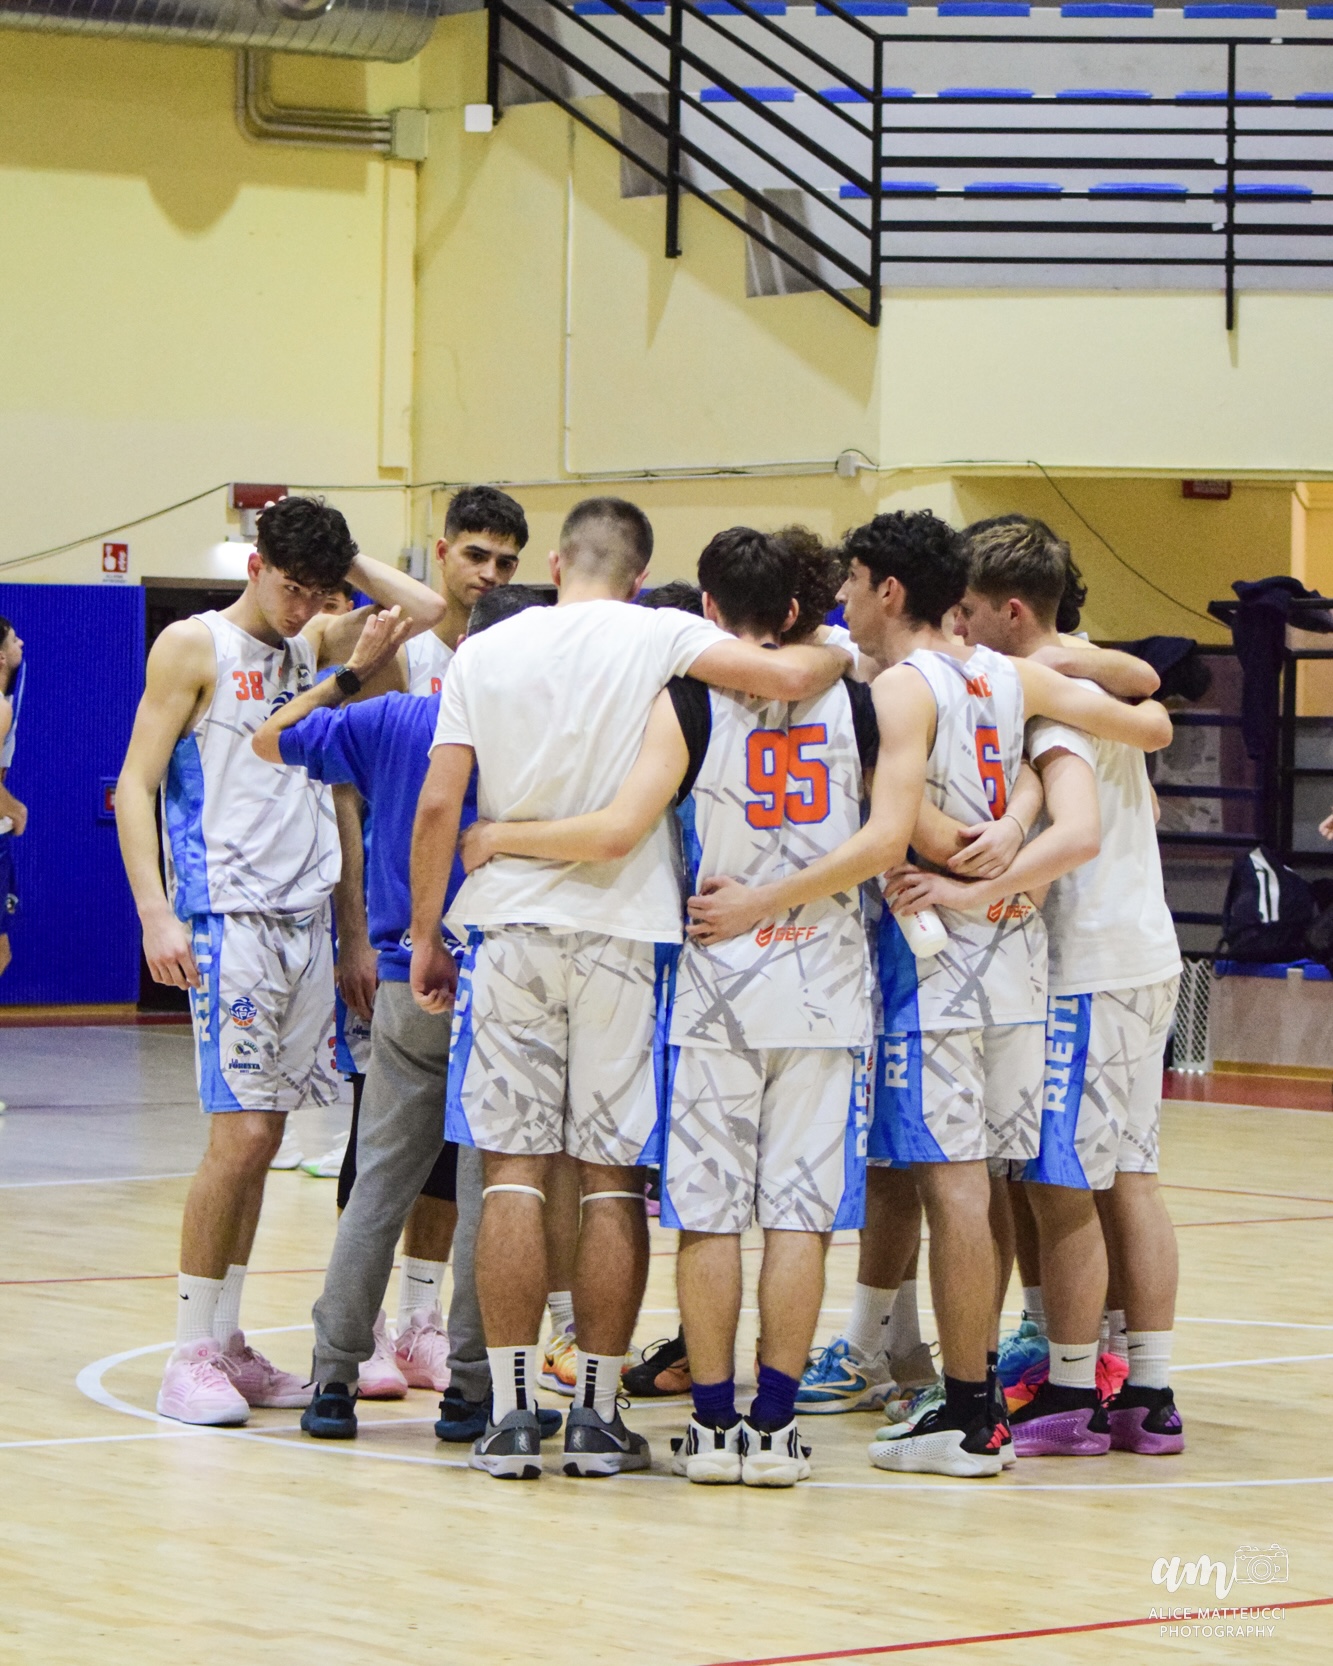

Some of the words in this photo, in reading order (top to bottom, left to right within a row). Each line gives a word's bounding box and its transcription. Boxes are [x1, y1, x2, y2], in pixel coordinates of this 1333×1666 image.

[232, 671, 265, 701] 38
[745, 723, 830, 830] 95
[774, 925, 818, 942] GEFF
[1042, 996, 1079, 1112] RIETI
